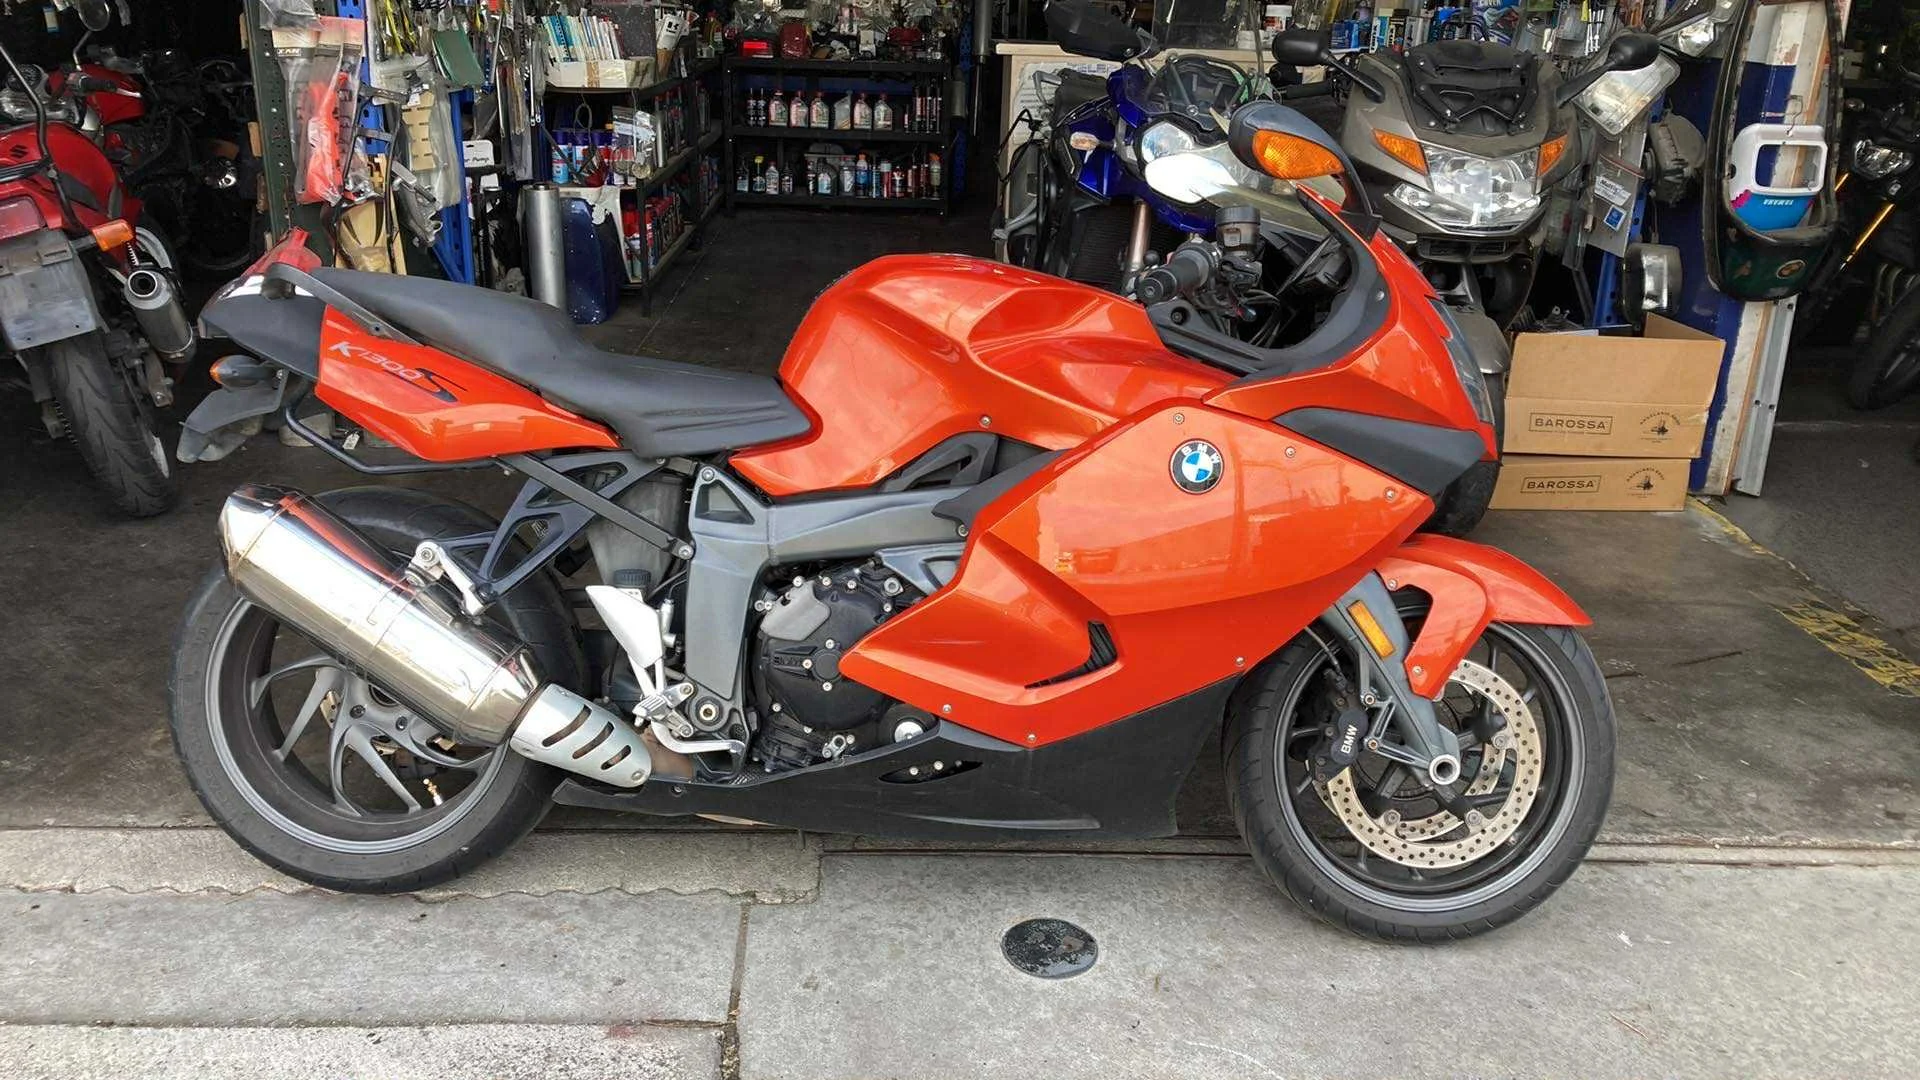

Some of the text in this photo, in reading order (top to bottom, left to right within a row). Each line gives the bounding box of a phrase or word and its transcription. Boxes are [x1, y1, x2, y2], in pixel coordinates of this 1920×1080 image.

[1535, 418, 1606, 430] BAROSSA
[1181, 443, 1221, 464] BMW
[1527, 480, 1594, 490] BAROSSA
[1341, 724, 1358, 754] BMW
